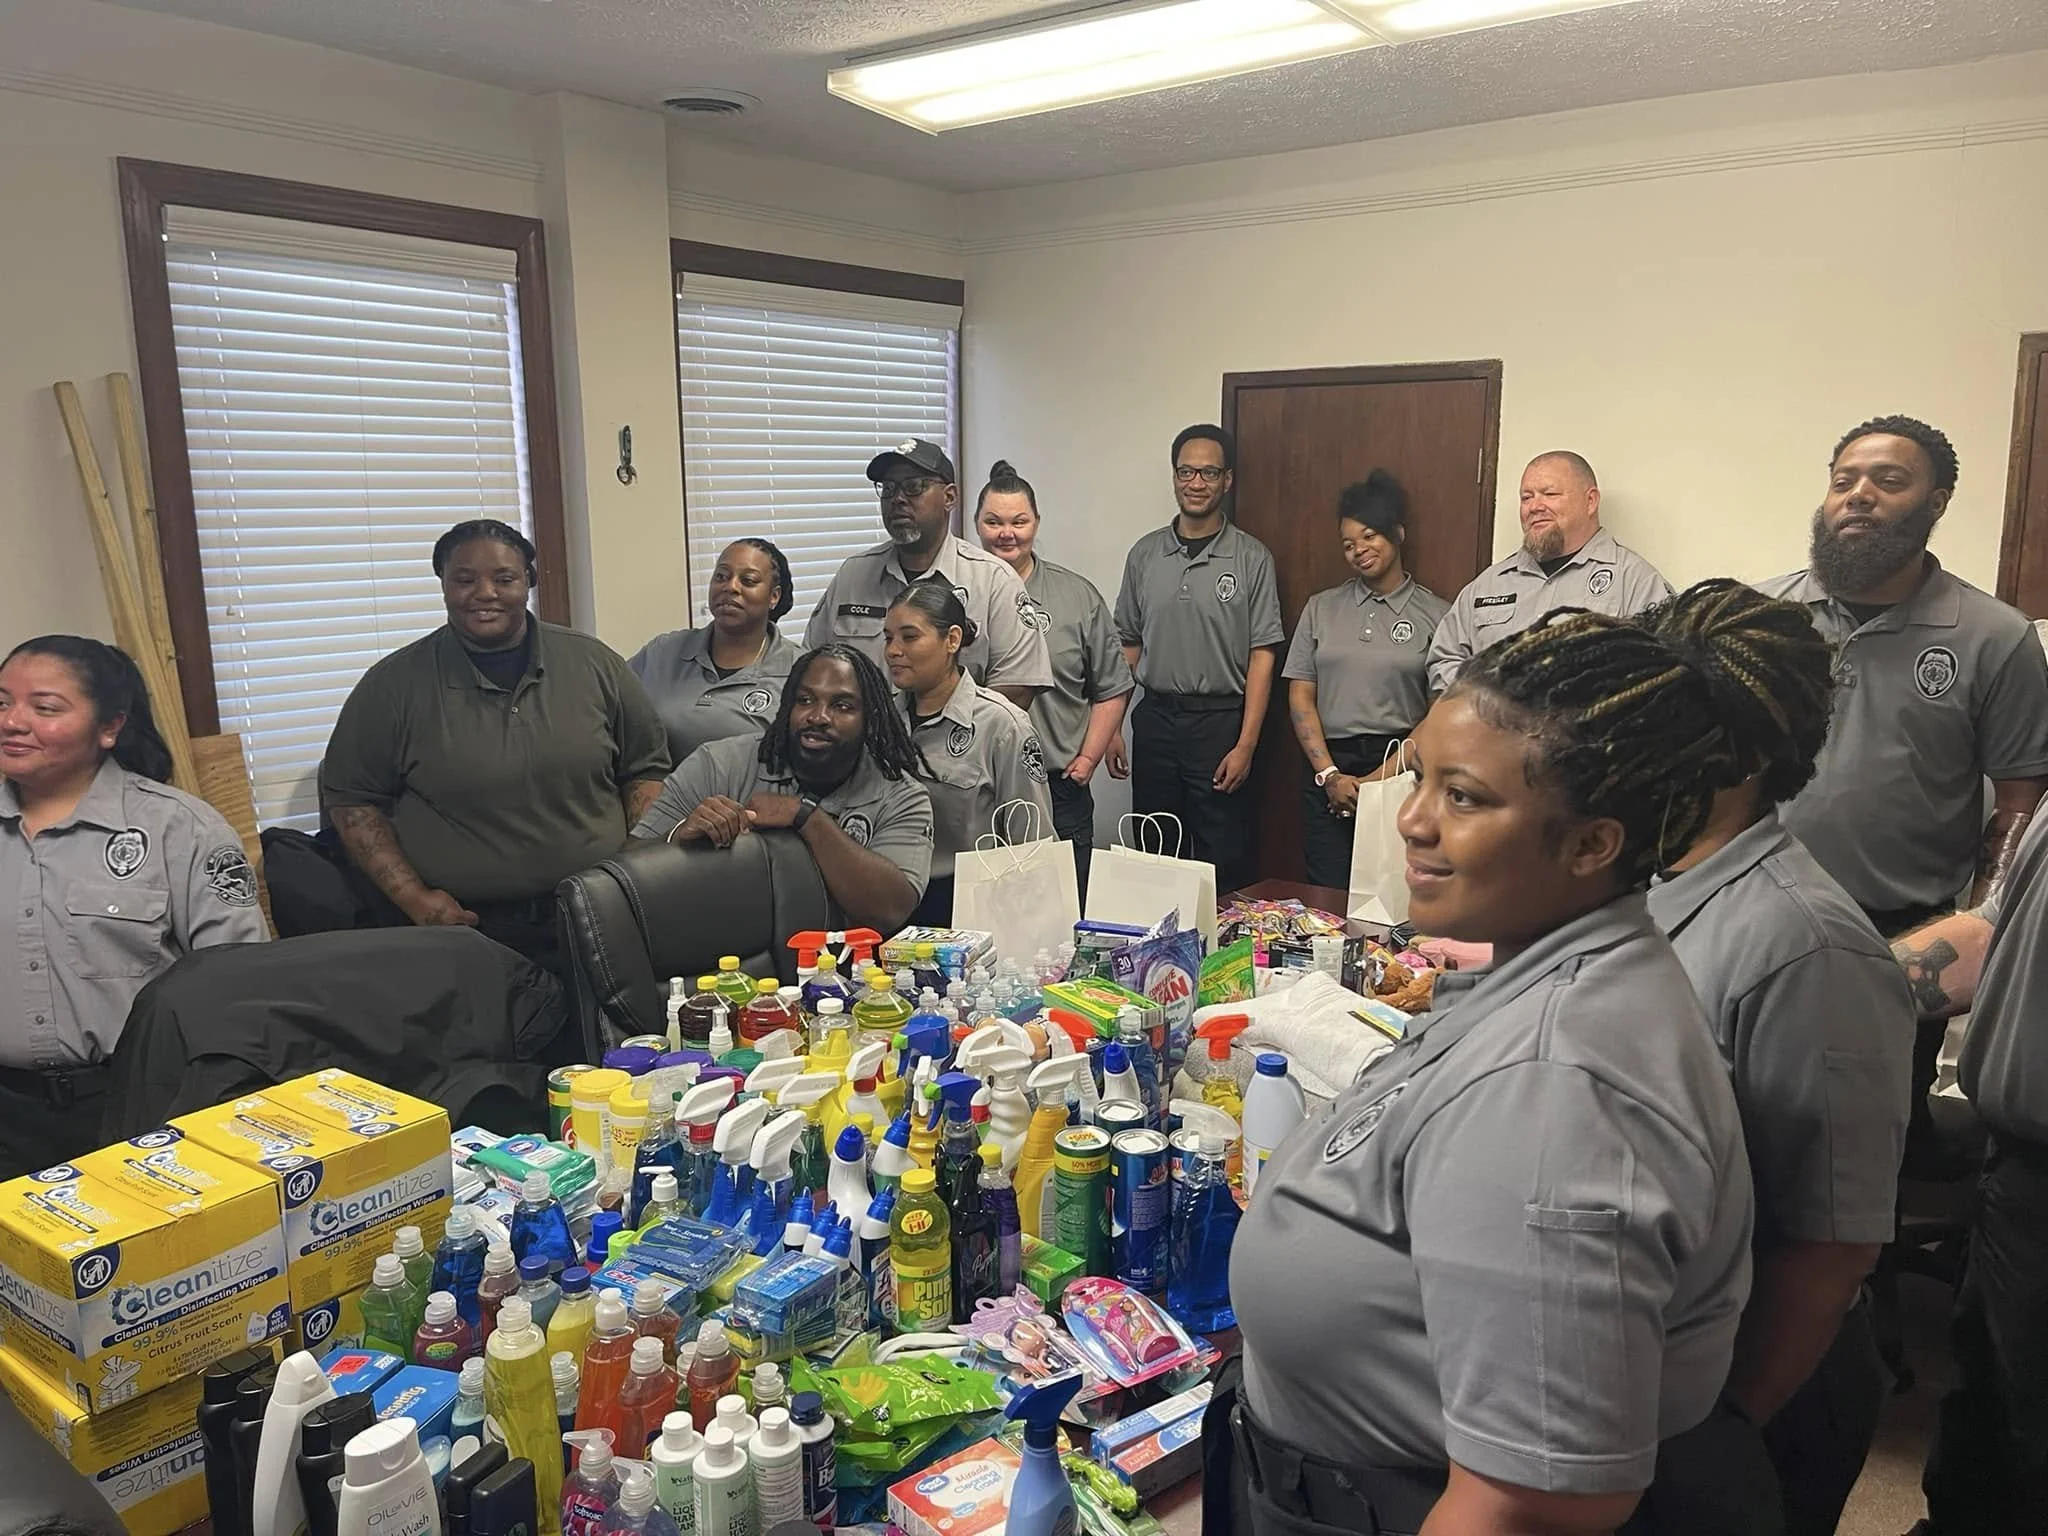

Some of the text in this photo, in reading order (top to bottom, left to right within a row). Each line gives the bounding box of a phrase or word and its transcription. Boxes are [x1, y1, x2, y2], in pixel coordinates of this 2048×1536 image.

[850, 606, 870, 614] COLE
[1117, 956, 1132, 970] 30
[310, 1171, 434, 1236] Cleanitize
[310, 1231, 348, 1251] Cleaning
[365, 1204, 413, 1229] Disinfecting
[412, 1193, 438, 1210] Wipes
[324, 1237, 362, 1261] 99.9%
[109, 1248, 264, 1326] Cleanitize
[114, 1319, 160, 1343] Cleaning
[180, 1286, 239, 1316] Disinfecting
[239, 1272, 270, 1293] Wipes
[132, 1324, 179, 1353] 99.9%
[148, 1338, 183, 1359] Citrus
[184, 1326, 211, 1344] Fruit
[212, 1312, 244, 1332] Scent
[143, 1430, 202, 1461] Disinfecting
[108, 1456, 142, 1476] Wipes
[115, 1448, 205, 1498] anitize
[673, 1511, 695, 1523] HAN
